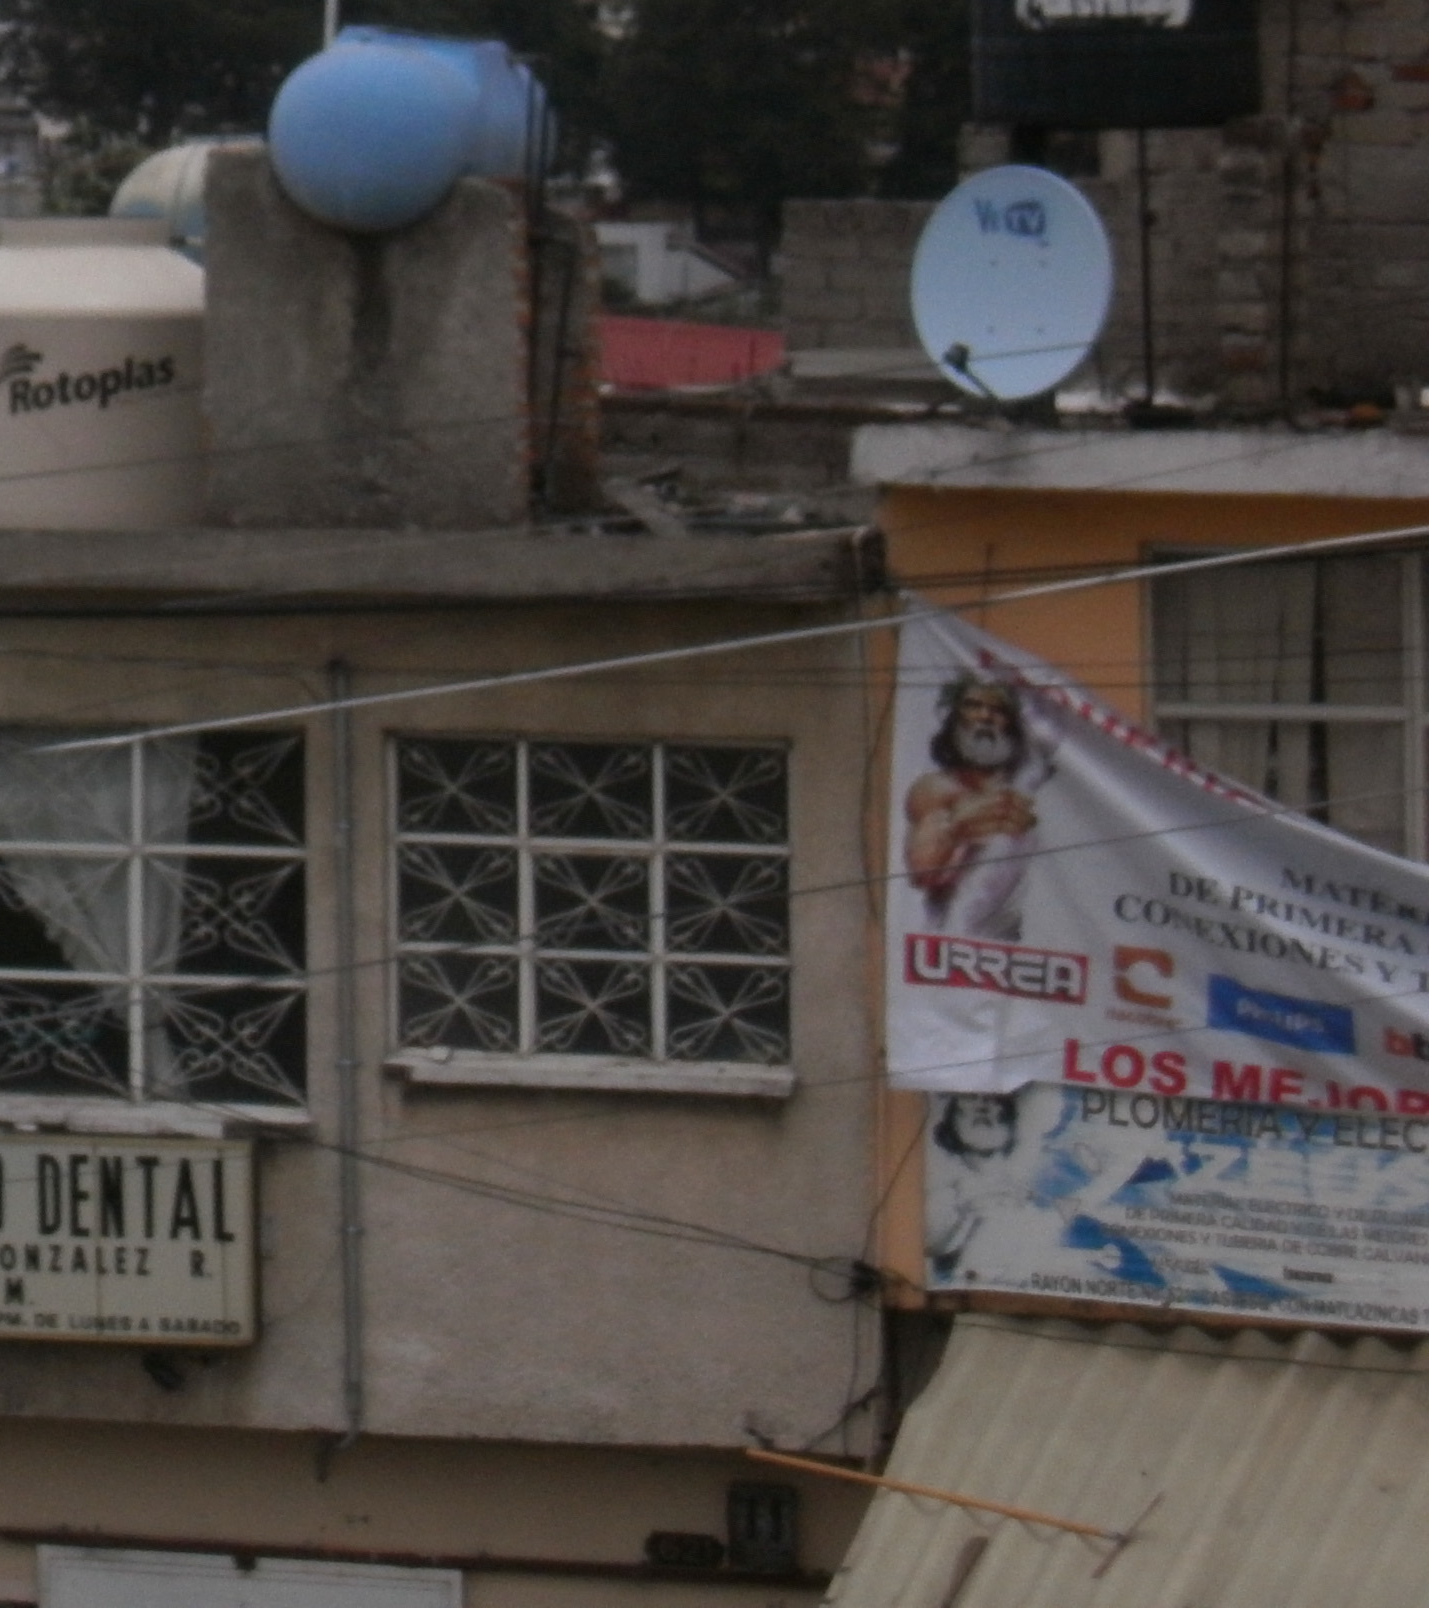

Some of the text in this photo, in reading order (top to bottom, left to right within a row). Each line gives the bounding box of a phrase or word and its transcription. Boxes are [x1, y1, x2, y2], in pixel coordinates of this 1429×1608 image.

[9, 356, 175, 416] Rotoplas
[1114, 892, 1364, 975] CONEXIONES
[1169, 872, 1415, 956] DE PRIMERA
[913, 939, 1083, 999] URREA
[1062, 1037, 1187, 1097] LOS
[1080, 1088, 1282, 1139] PLOMERIA
[37, 1153, 234, 1242] DENTAL
